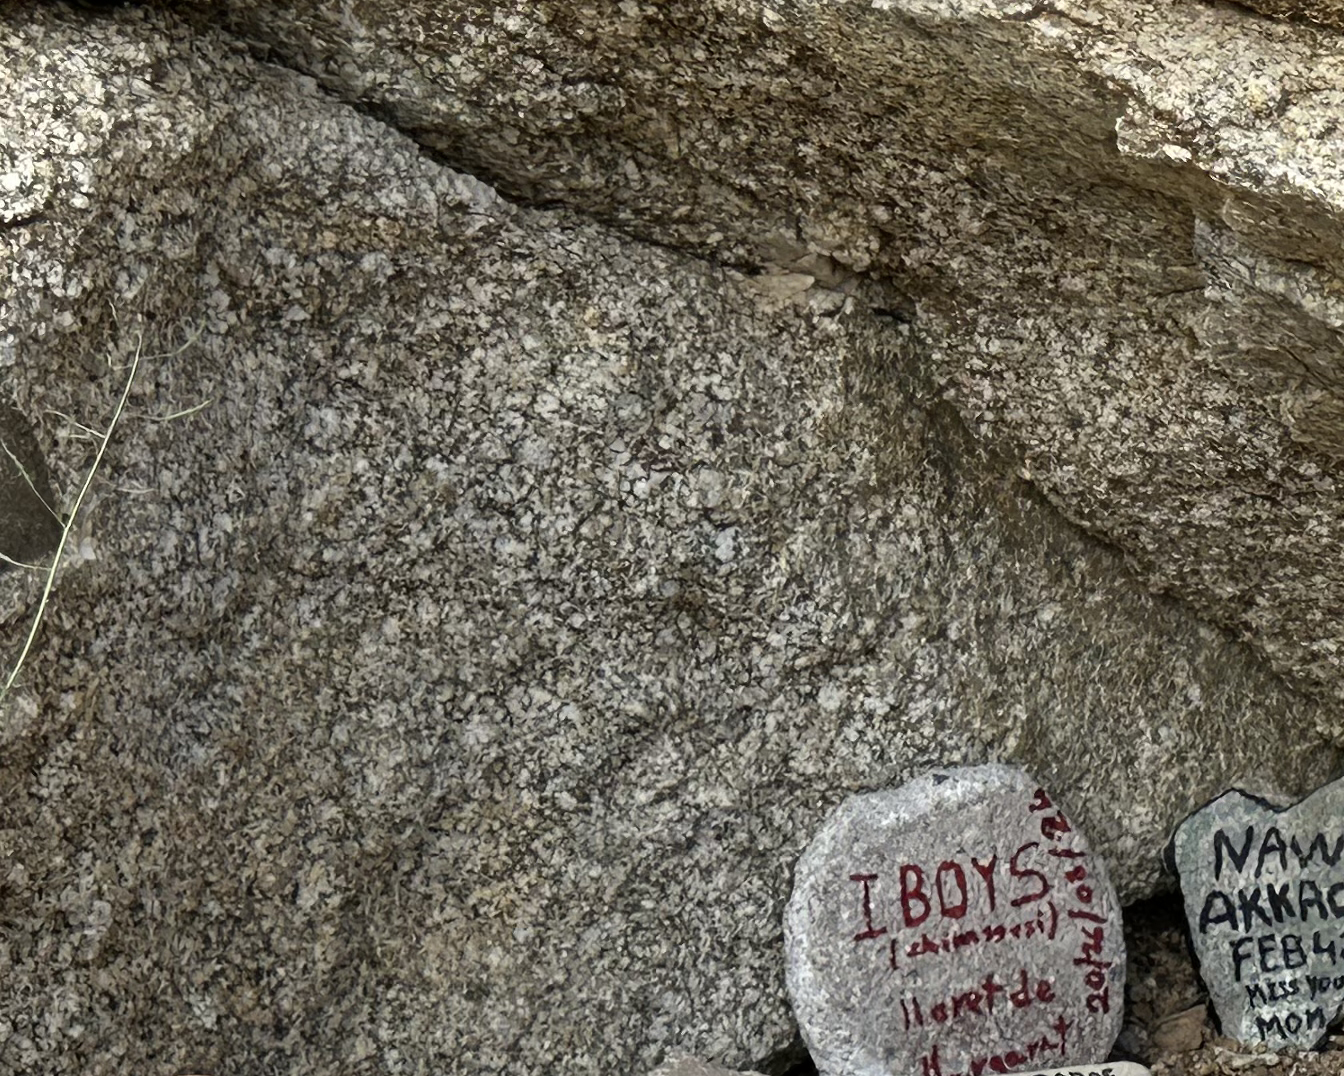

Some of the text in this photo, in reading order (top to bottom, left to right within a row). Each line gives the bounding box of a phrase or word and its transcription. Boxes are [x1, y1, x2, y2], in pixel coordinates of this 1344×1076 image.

[900, 841, 1053, 929] BOYS
[1229, 929, 1308, 982] FEB
[1311, 930, 1337, 965] 4
[1009, 969, 1057, 1010] de
[1245, 976, 1301, 1009] MISS
[1255, 1006, 1327, 1042] MOM
